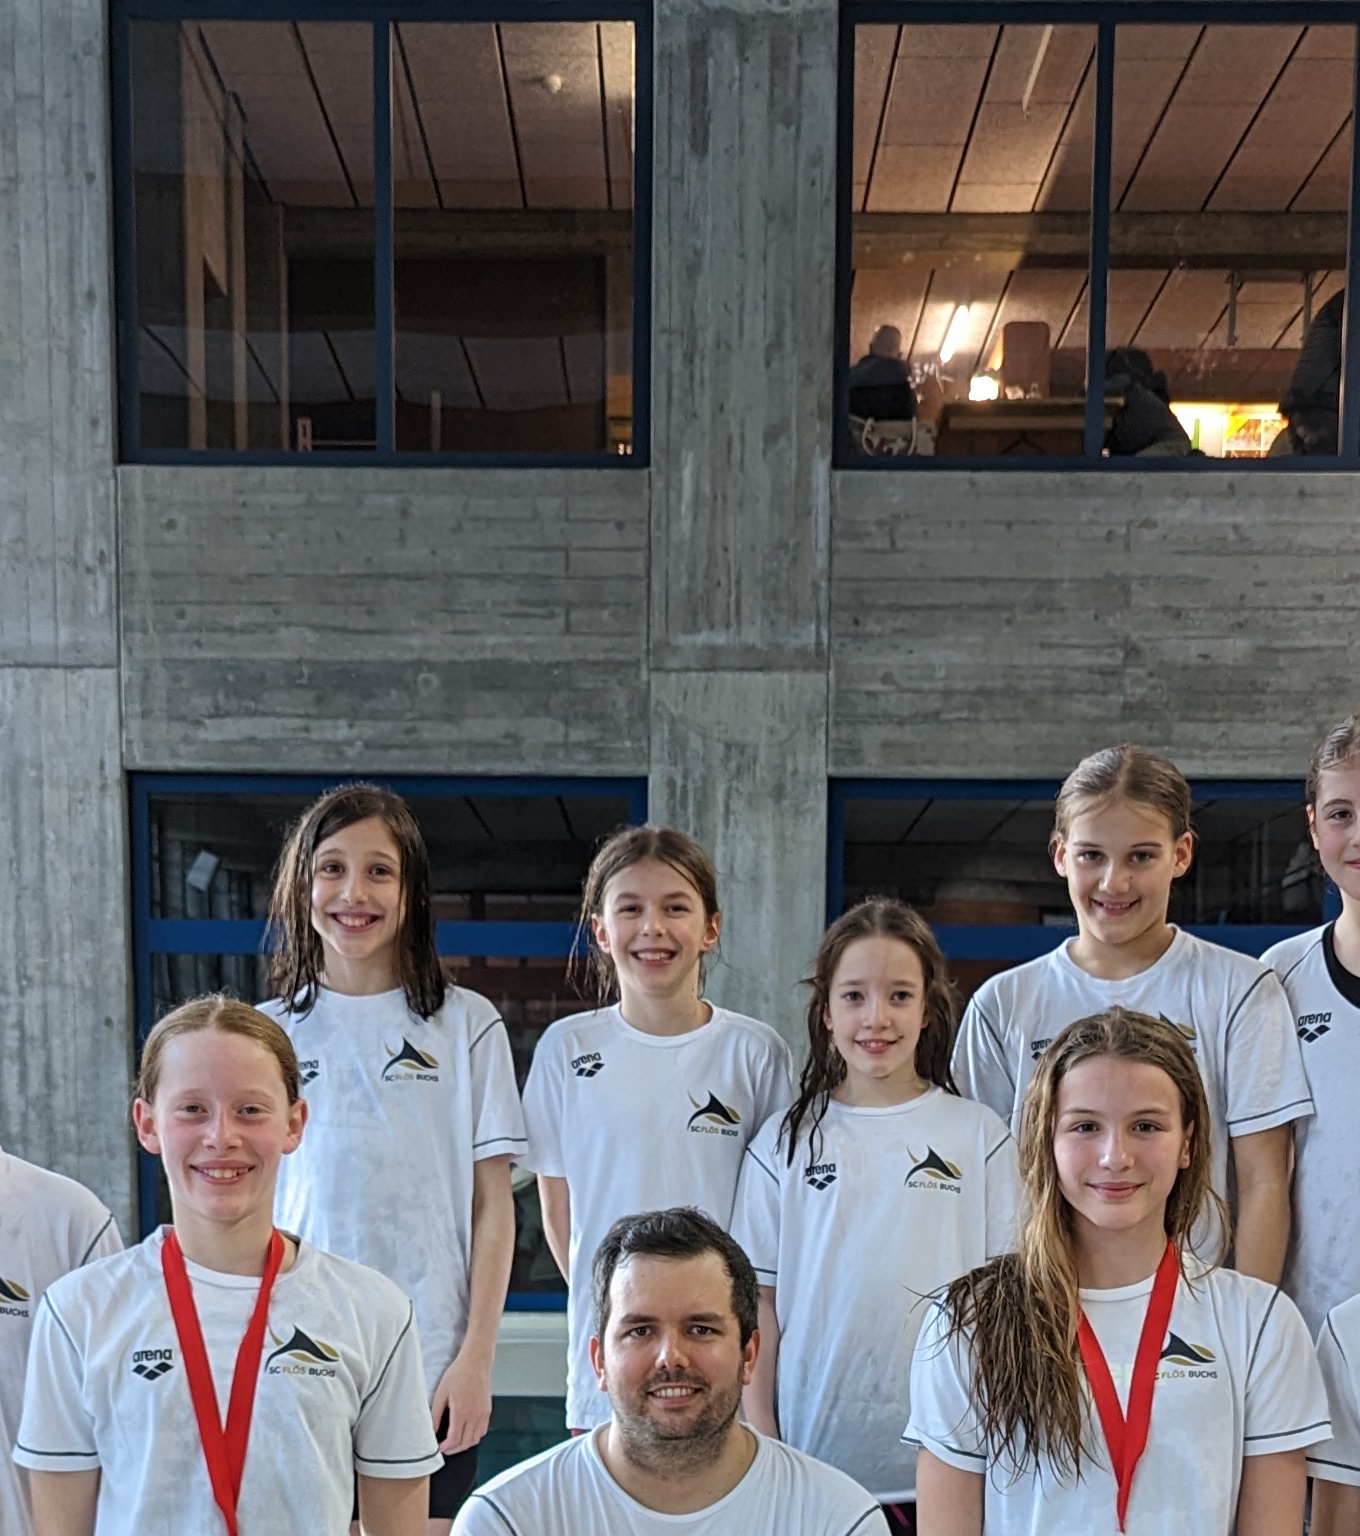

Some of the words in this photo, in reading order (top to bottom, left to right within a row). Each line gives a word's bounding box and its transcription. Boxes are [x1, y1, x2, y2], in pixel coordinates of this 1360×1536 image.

[1298, 1012, 1332, 1027] arena
[571, 1052, 602, 1070] arena
[133, 1349, 173, 1363] arena
[269, 1366, 281, 1374] SC
[1161, 1370, 1185, 1379] FLÖS
[1188, 1370, 1217, 1379] BUCHS
